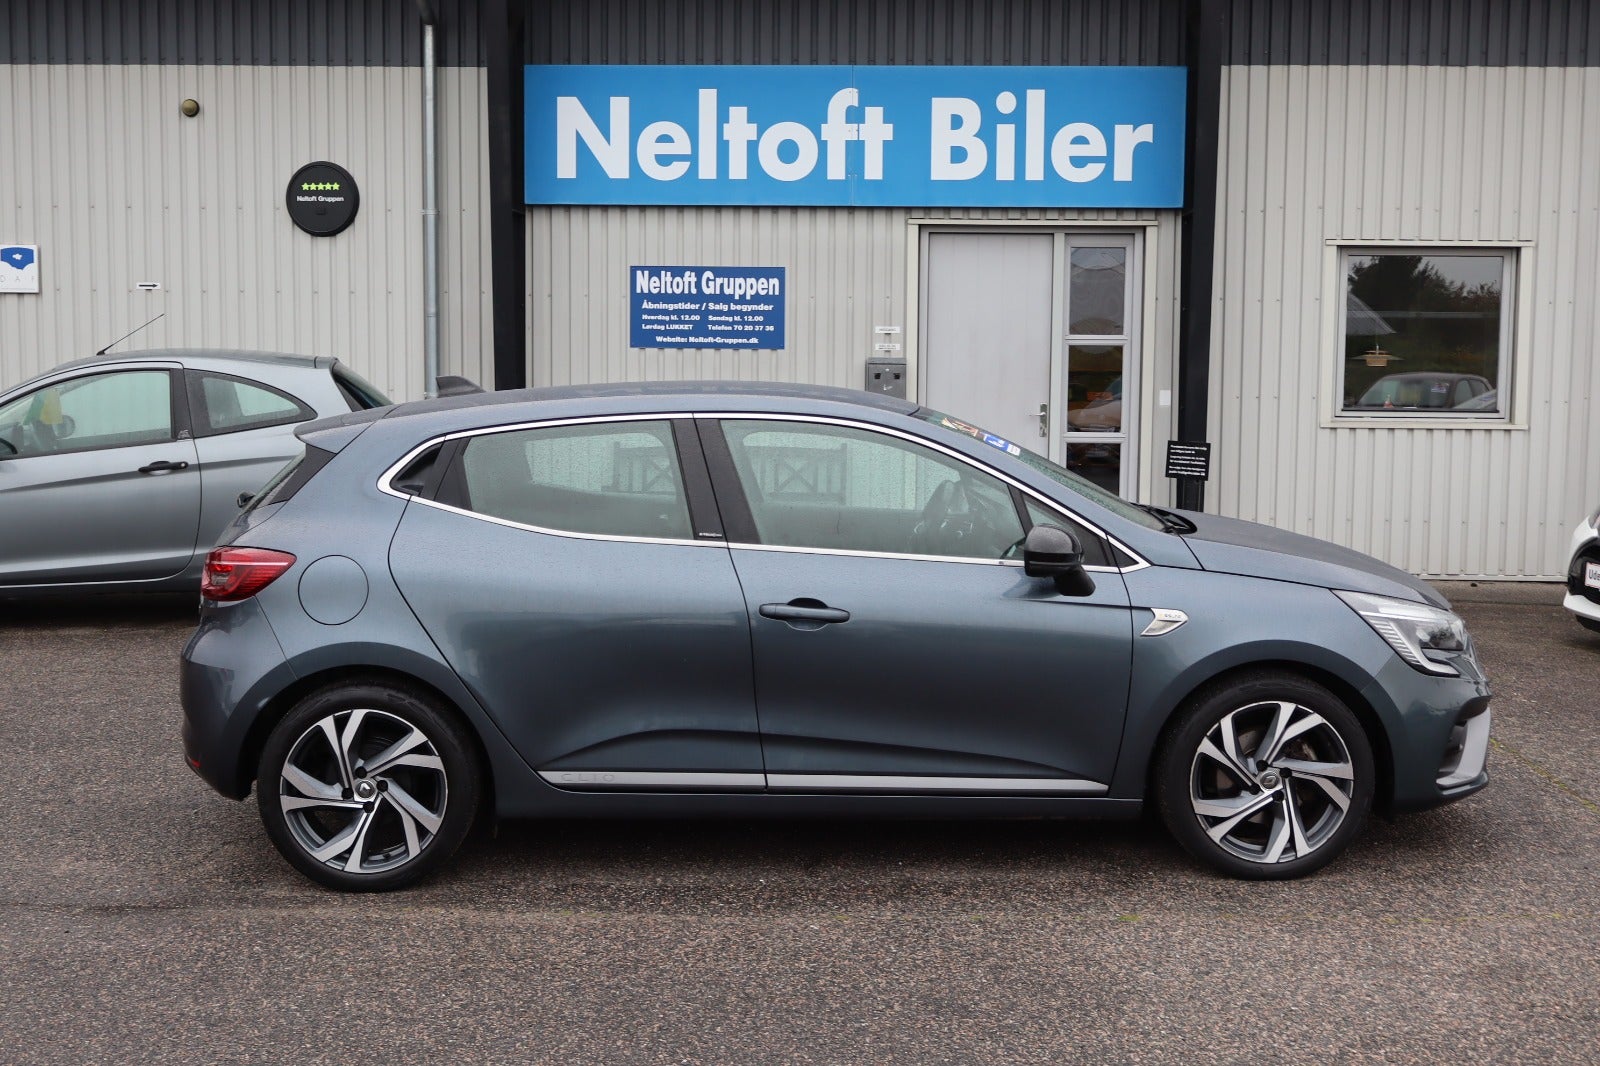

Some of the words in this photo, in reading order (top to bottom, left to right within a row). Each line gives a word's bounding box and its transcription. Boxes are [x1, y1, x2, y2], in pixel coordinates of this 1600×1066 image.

[556, 88, 893, 181] Neltoft
[930, 89, 1153, 182] Biler
[636, 270, 697, 294] Neltoft
[701, 271, 780, 300] Gruppen
[642, 300, 700, 310] Åbningstider
[708, 303, 729, 311] Salg
[730, 303, 774, 312] begynder
[689, 336, 759, 344] Neltoft-Gruppen.dk
[561, 773, 615, 782] CLIO
